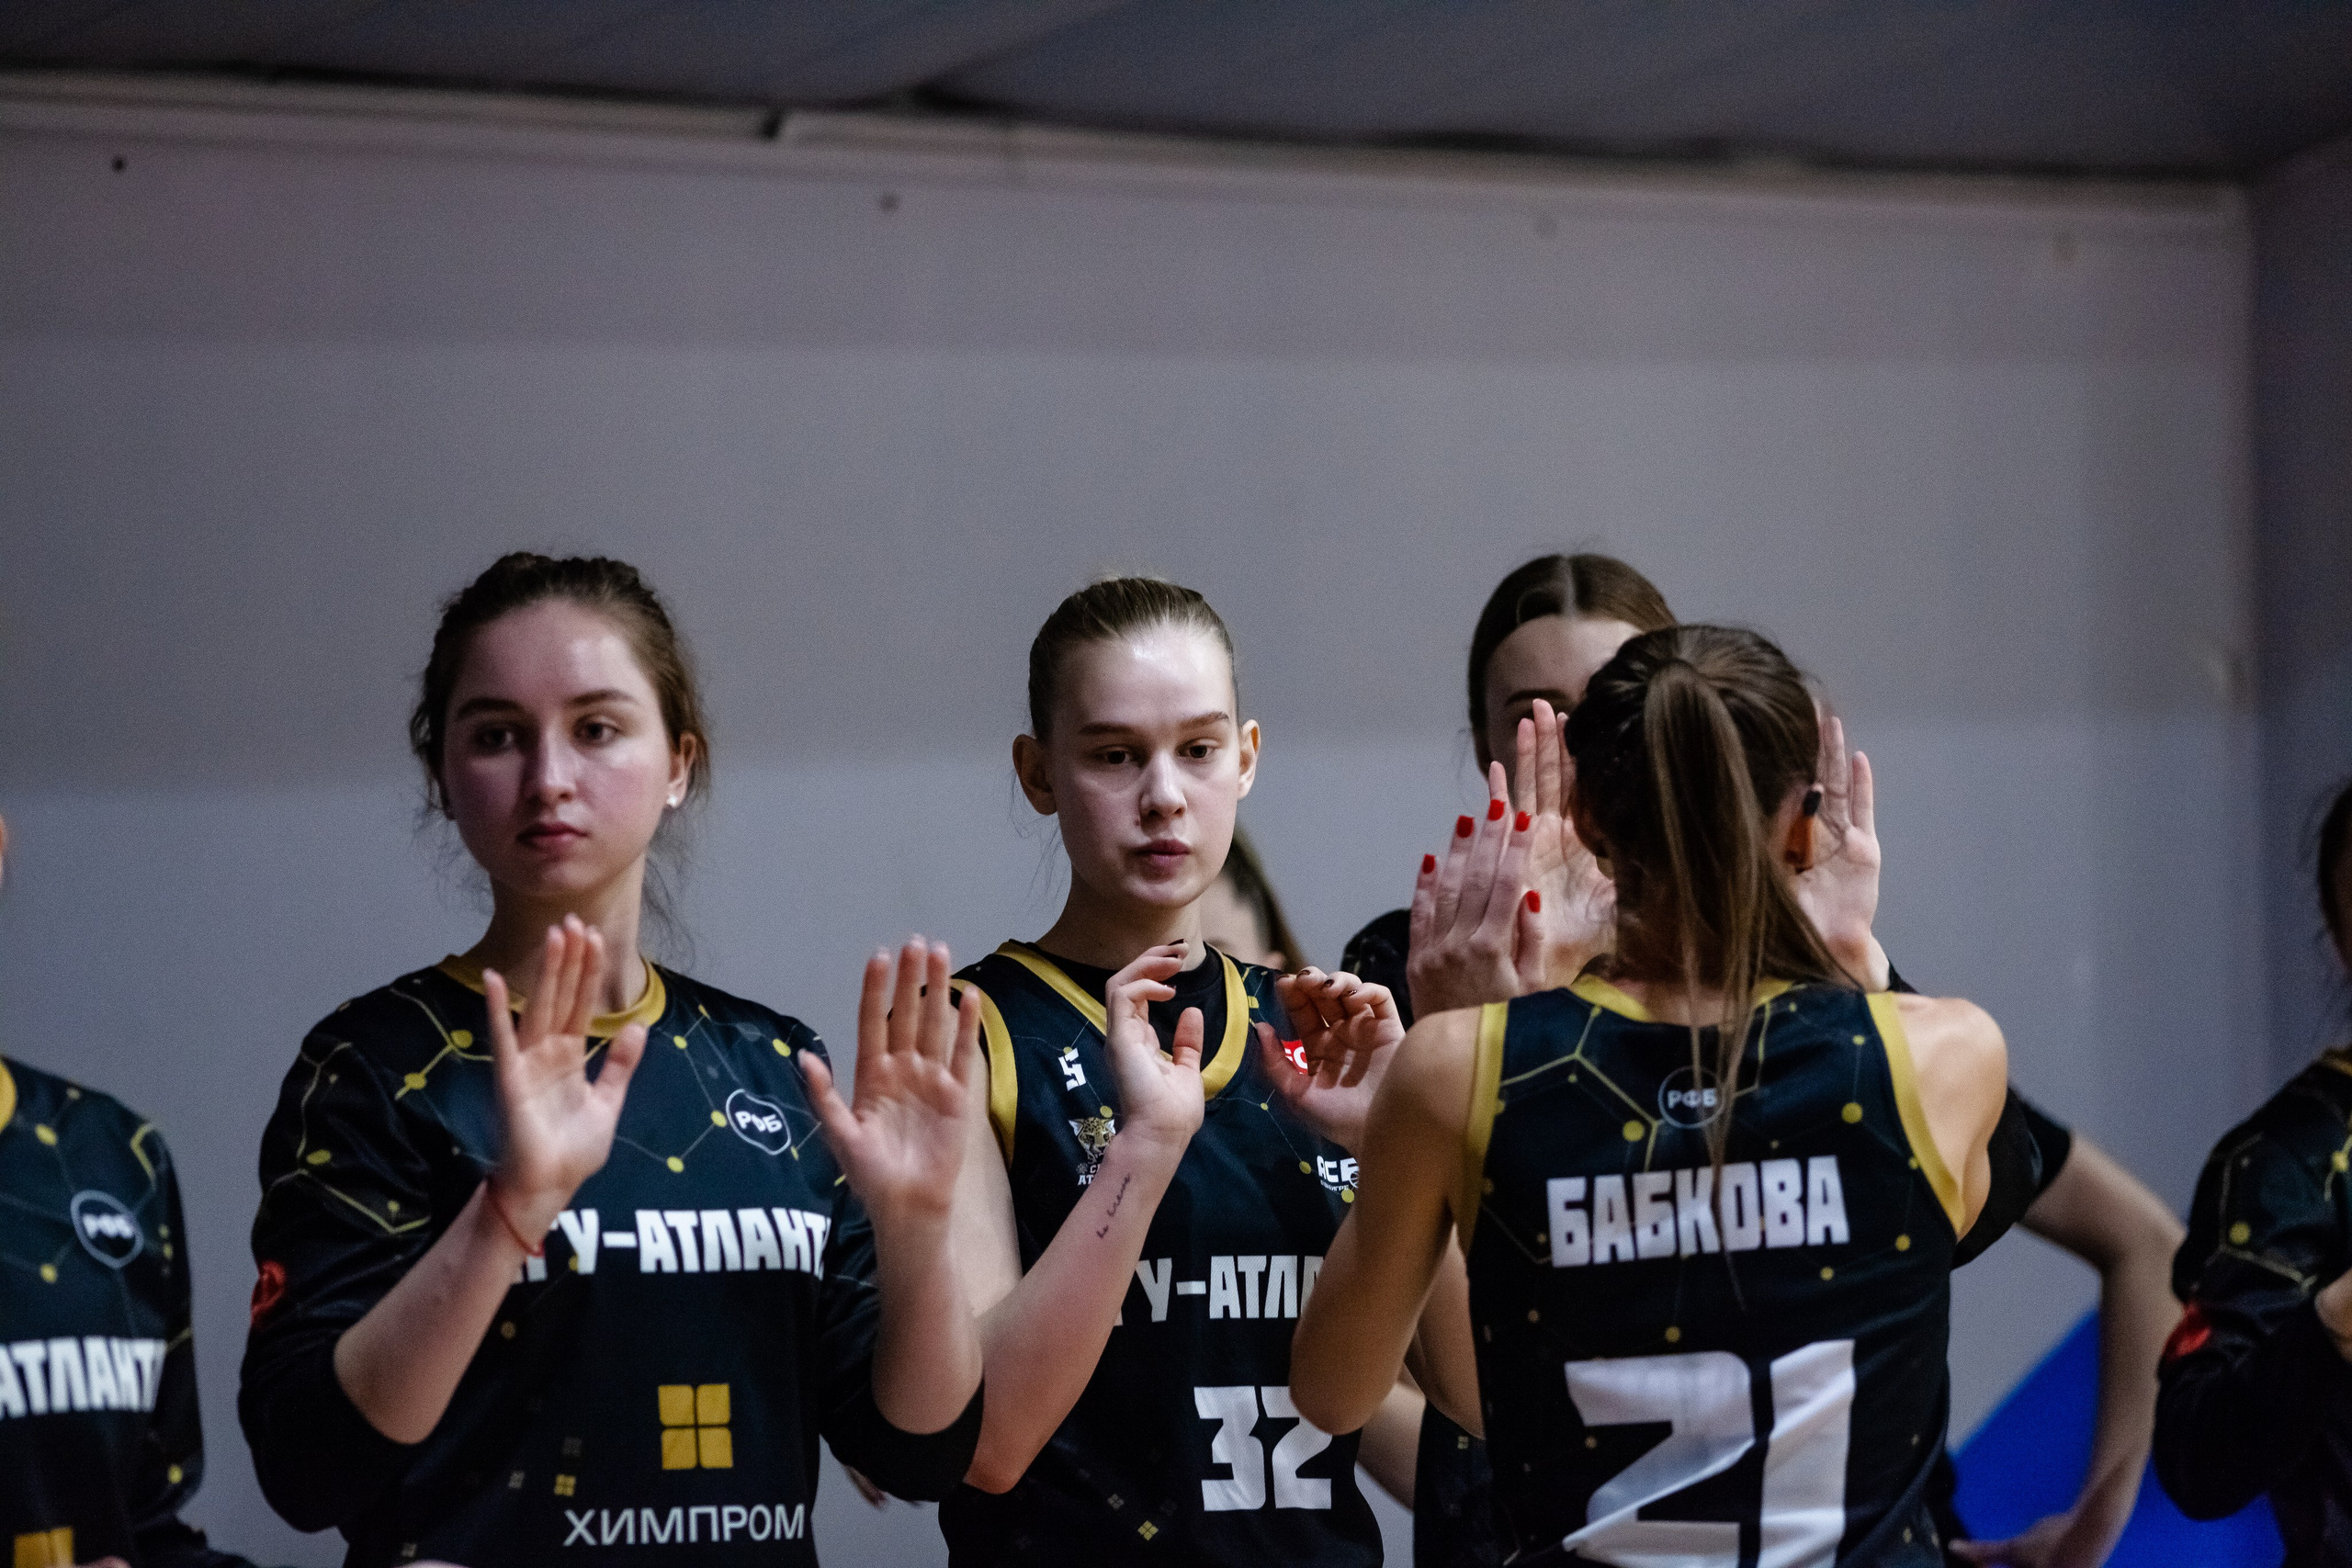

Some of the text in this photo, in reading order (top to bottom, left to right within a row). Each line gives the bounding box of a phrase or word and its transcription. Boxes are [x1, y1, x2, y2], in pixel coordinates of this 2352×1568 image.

[1546, 1155, 1849, 1268] БАБКОВА
[1194, 1385, 1332, 1512] 32
[1562, 1339, 1855, 1568] 21
[562, 1504, 805, 1547] ХИМПРОМ
